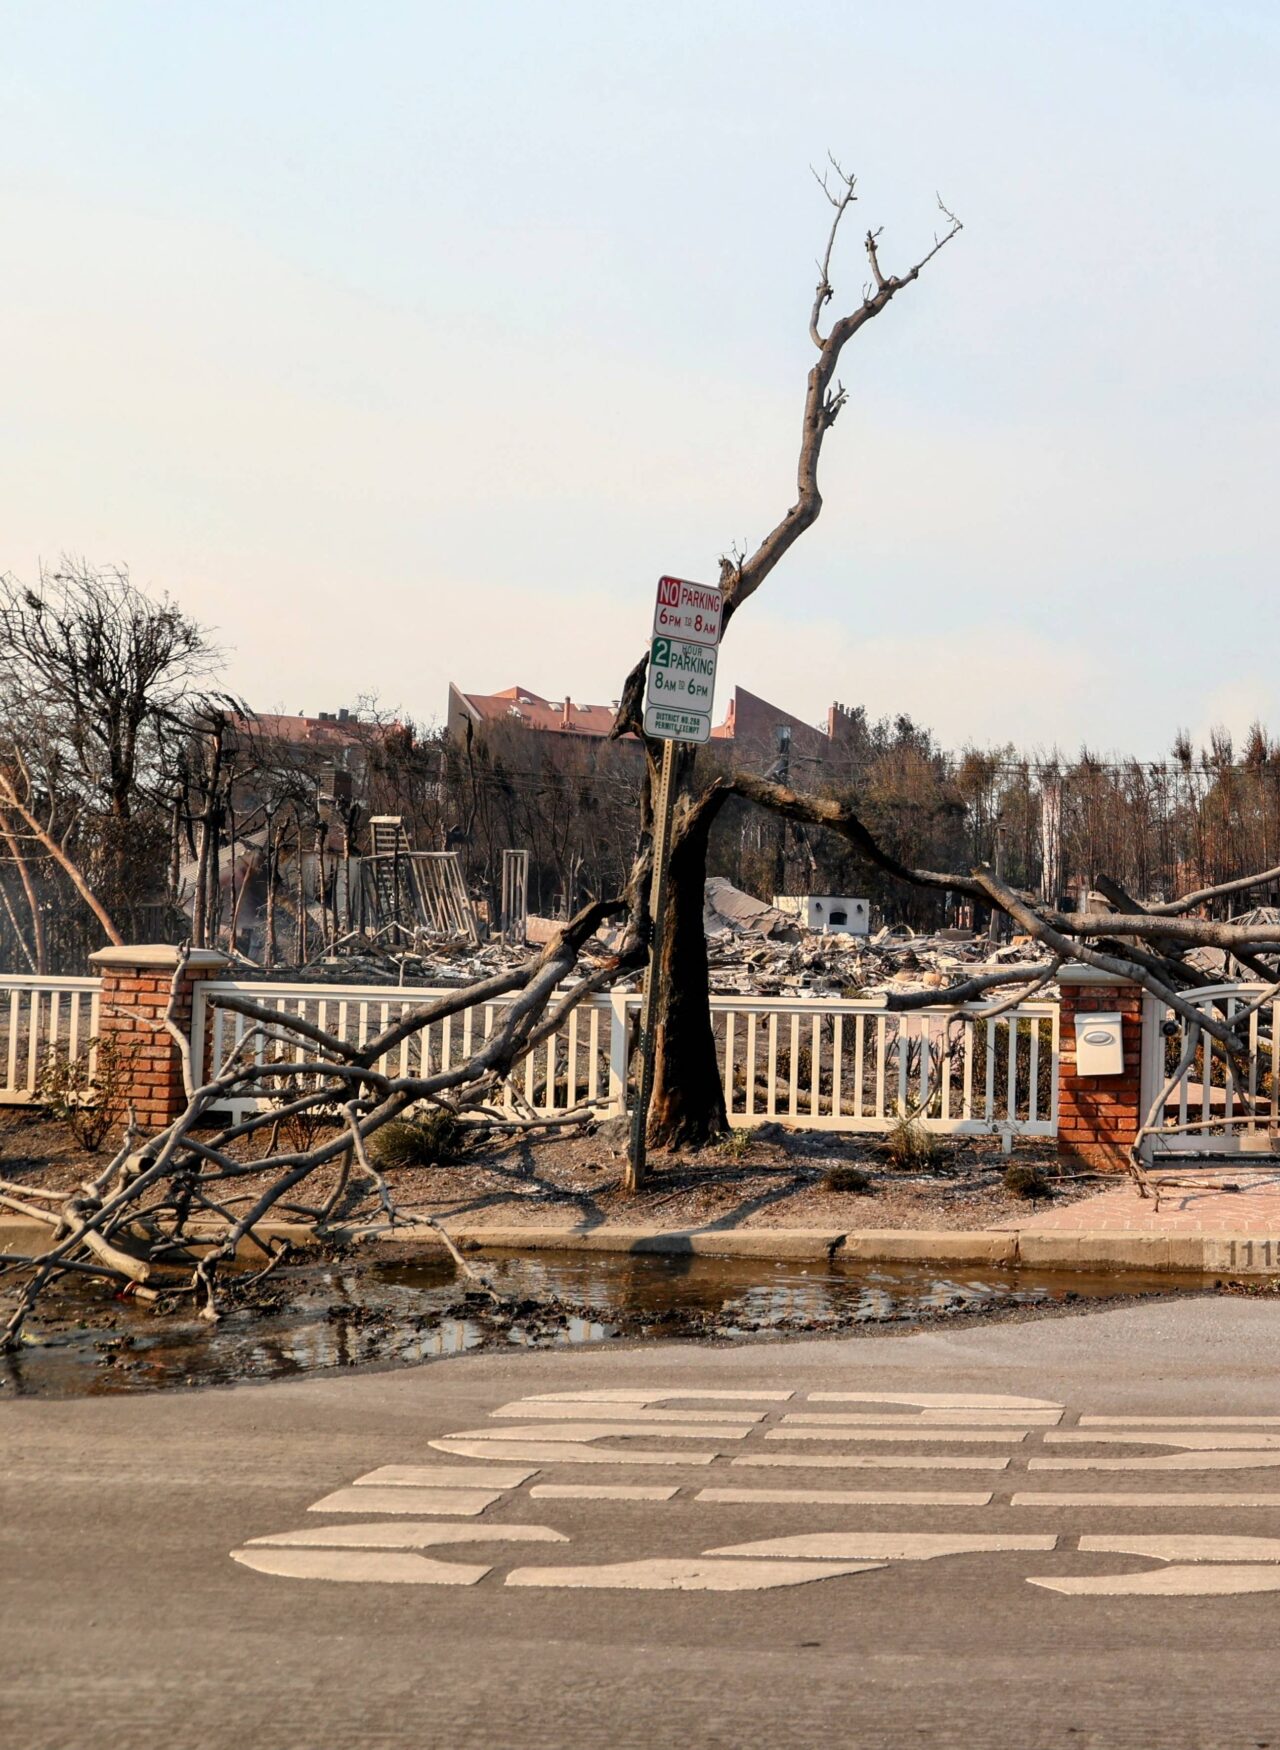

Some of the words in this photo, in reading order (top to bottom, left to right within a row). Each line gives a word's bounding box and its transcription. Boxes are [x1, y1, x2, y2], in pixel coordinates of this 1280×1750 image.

[660, 580, 679, 605] NO
[681, 587, 720, 612] PARKING
[655, 640, 668, 664] 2
[682, 645, 703, 656] HOUR
[670, 653, 714, 676] PARKING
[656, 711, 680, 722] DISTRICT
